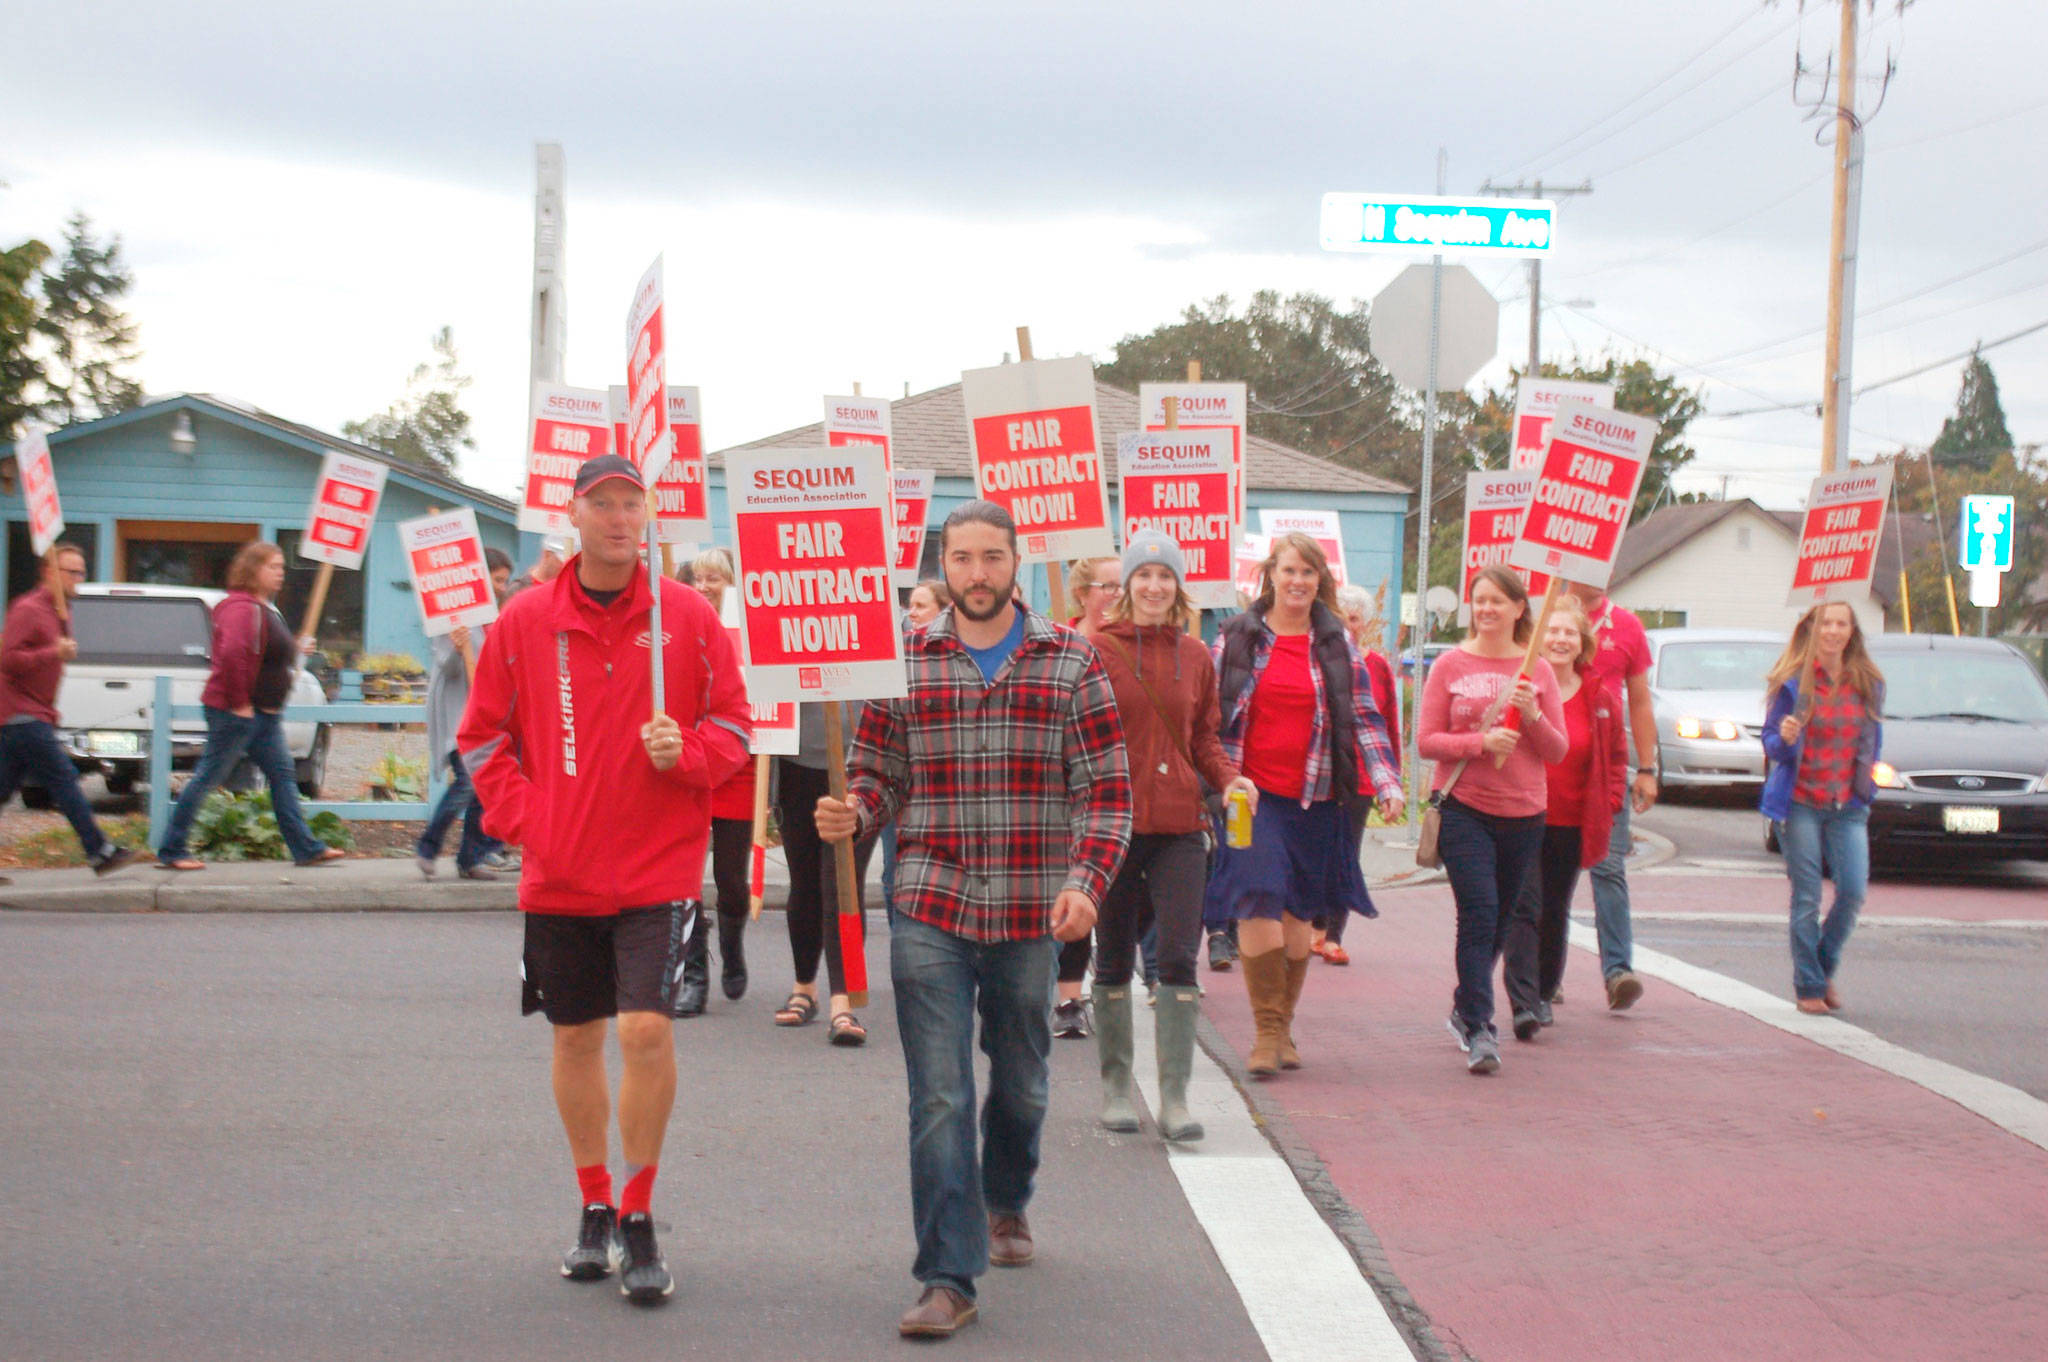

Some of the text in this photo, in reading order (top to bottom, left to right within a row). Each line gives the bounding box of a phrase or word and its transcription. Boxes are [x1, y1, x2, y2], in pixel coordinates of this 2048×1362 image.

[548, 396, 603, 413] SEQUIM
[836, 407, 879, 421] SEQUIM
[553, 428, 591, 453] FAIR
[1007, 418, 1062, 451] FAIR
[1572, 415, 1637, 442] SEQUIM
[1137, 444, 1211, 461] SEQUIM
[753, 466, 855, 491] SEQUIM
[982, 453, 1096, 492] CONTRACT
[1568, 452, 1614, 487] FAIR
[747, 491, 867, 505] Education Association
[1152, 482, 1200, 509] FAIR
[1485, 481, 1532, 497] SEQUI
[1824, 477, 1877, 496] SEQUIM
[1012, 492, 1077, 526] NOW!
[1536, 478, 1628, 523] CONTRACT
[1275, 519, 1325, 529] SEQUIM
[1493, 514, 1524, 539] FAI
[1544, 514, 1598, 550] NOW!
[1825, 507, 1862, 532] FAIR
[778, 521, 845, 560] FAIR
[1801, 529, 1878, 559] CONTRACT
[1811, 556, 1855, 581] NOW!
[744, 567, 889, 608] CONTRACT
[781, 615, 861, 653] NOW!
